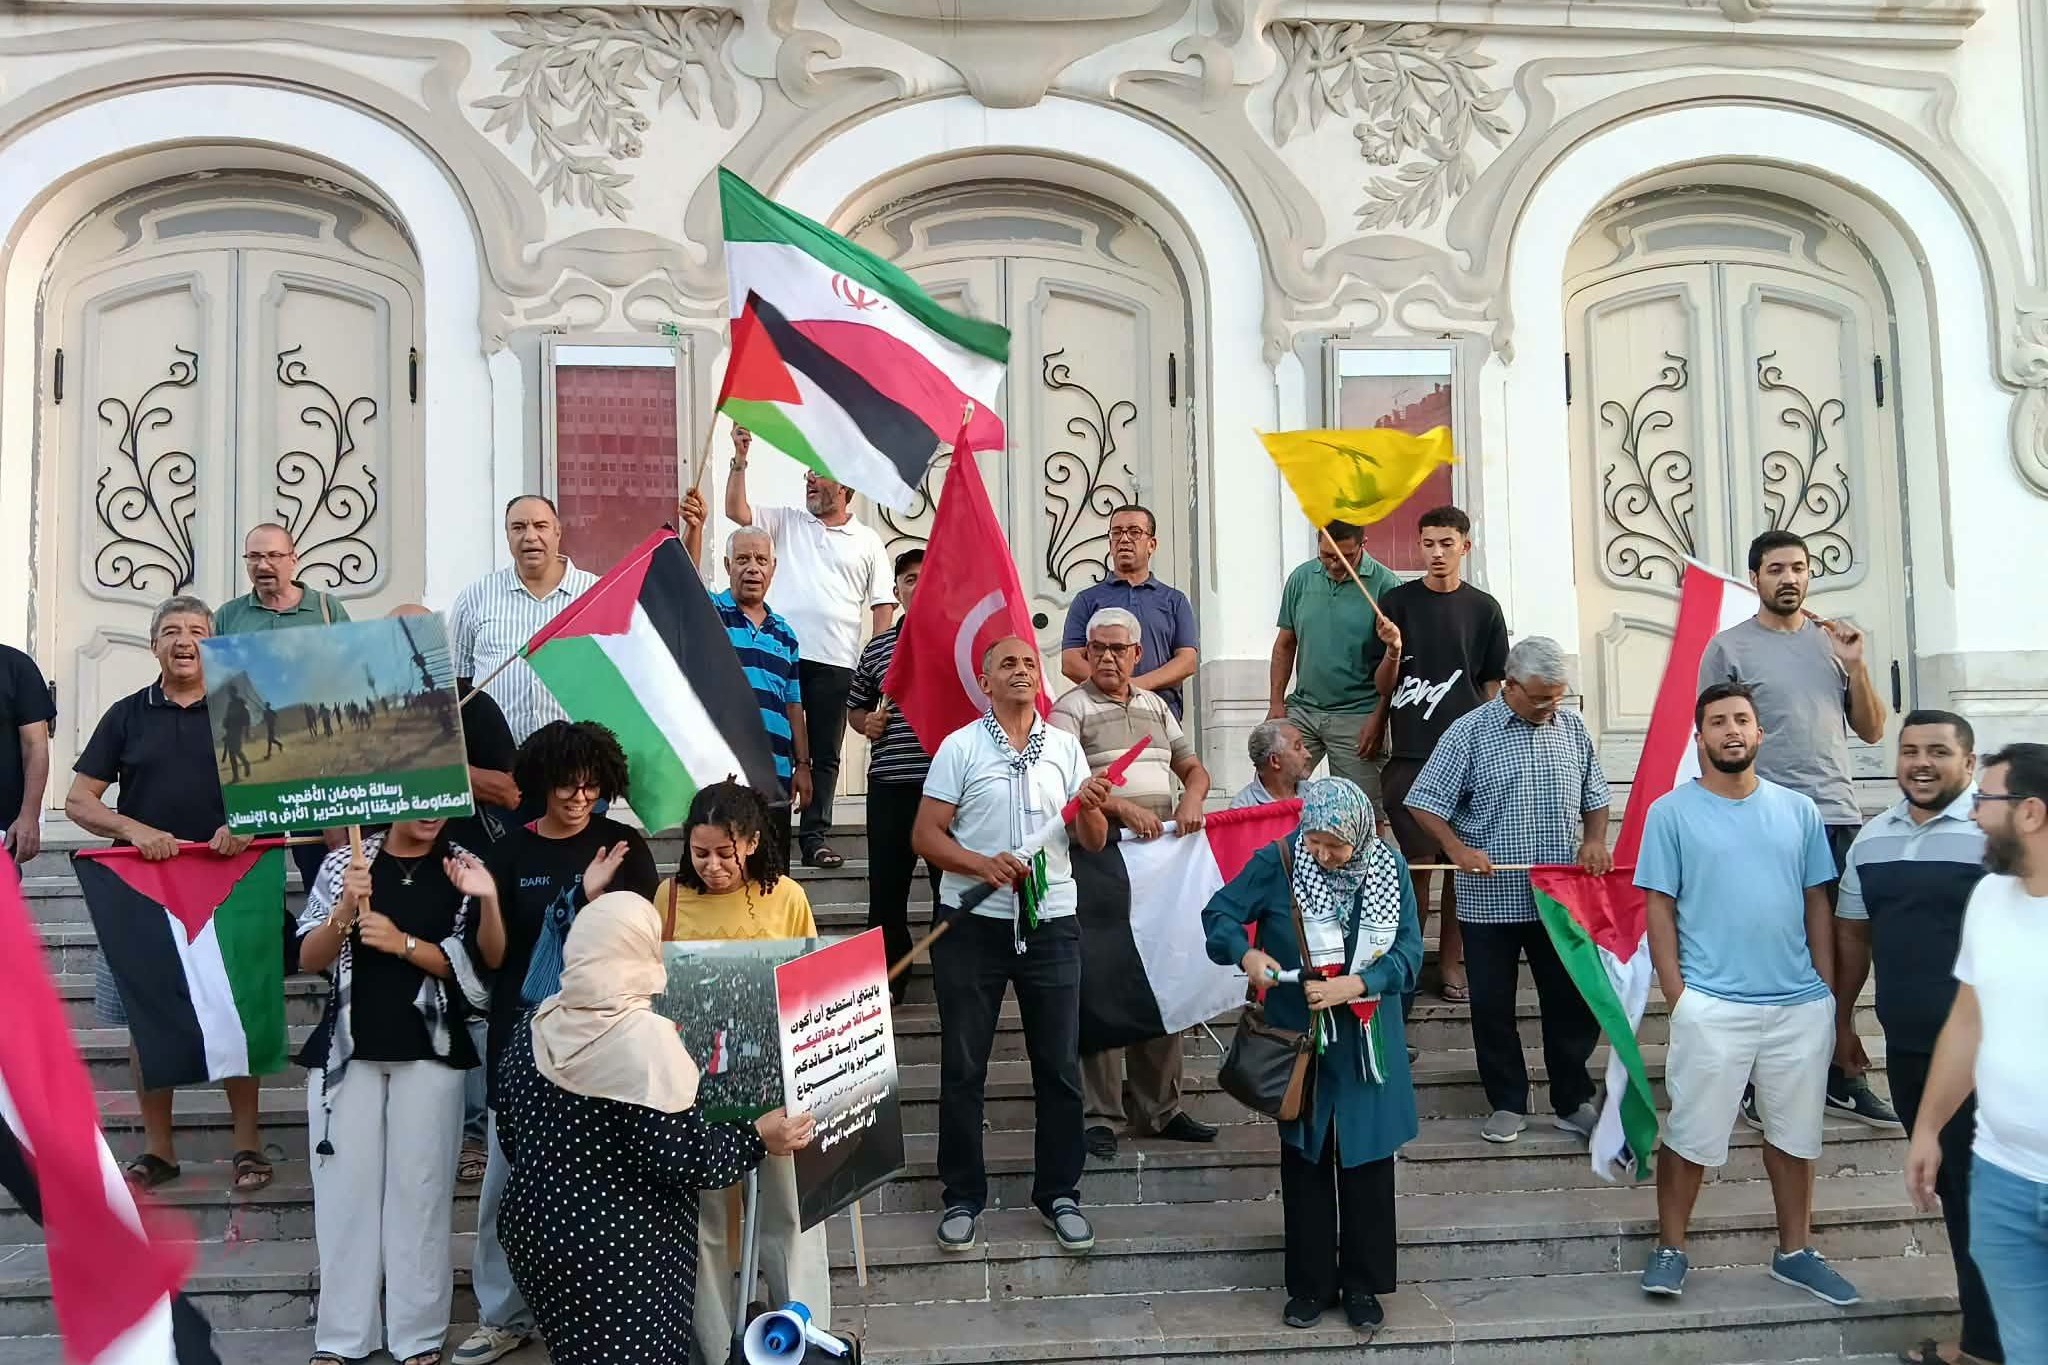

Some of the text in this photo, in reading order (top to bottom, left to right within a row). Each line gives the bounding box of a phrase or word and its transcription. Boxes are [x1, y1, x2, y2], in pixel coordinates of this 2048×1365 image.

[328, 785, 367, 801] طوفان
[369, 782, 403, 797] رسالة
[228, 791, 471, 828] المقاومة طريقنا إلى تحرير الأرض و الإنسان
[520, 876, 551, 887] DARK
[790, 1009, 812, 1034] أكون
[814, 1004, 824, 1024] أن
[837, 1020, 852, 1036] من
[859, 1022, 884, 1044] تحت
[792, 1026, 836, 1057] مقاتليكم
[794, 1044, 833, 1079] قائدكم
[856, 1043, 886, 1070] العزيز
[796, 1061, 855, 1100] والشجاع
